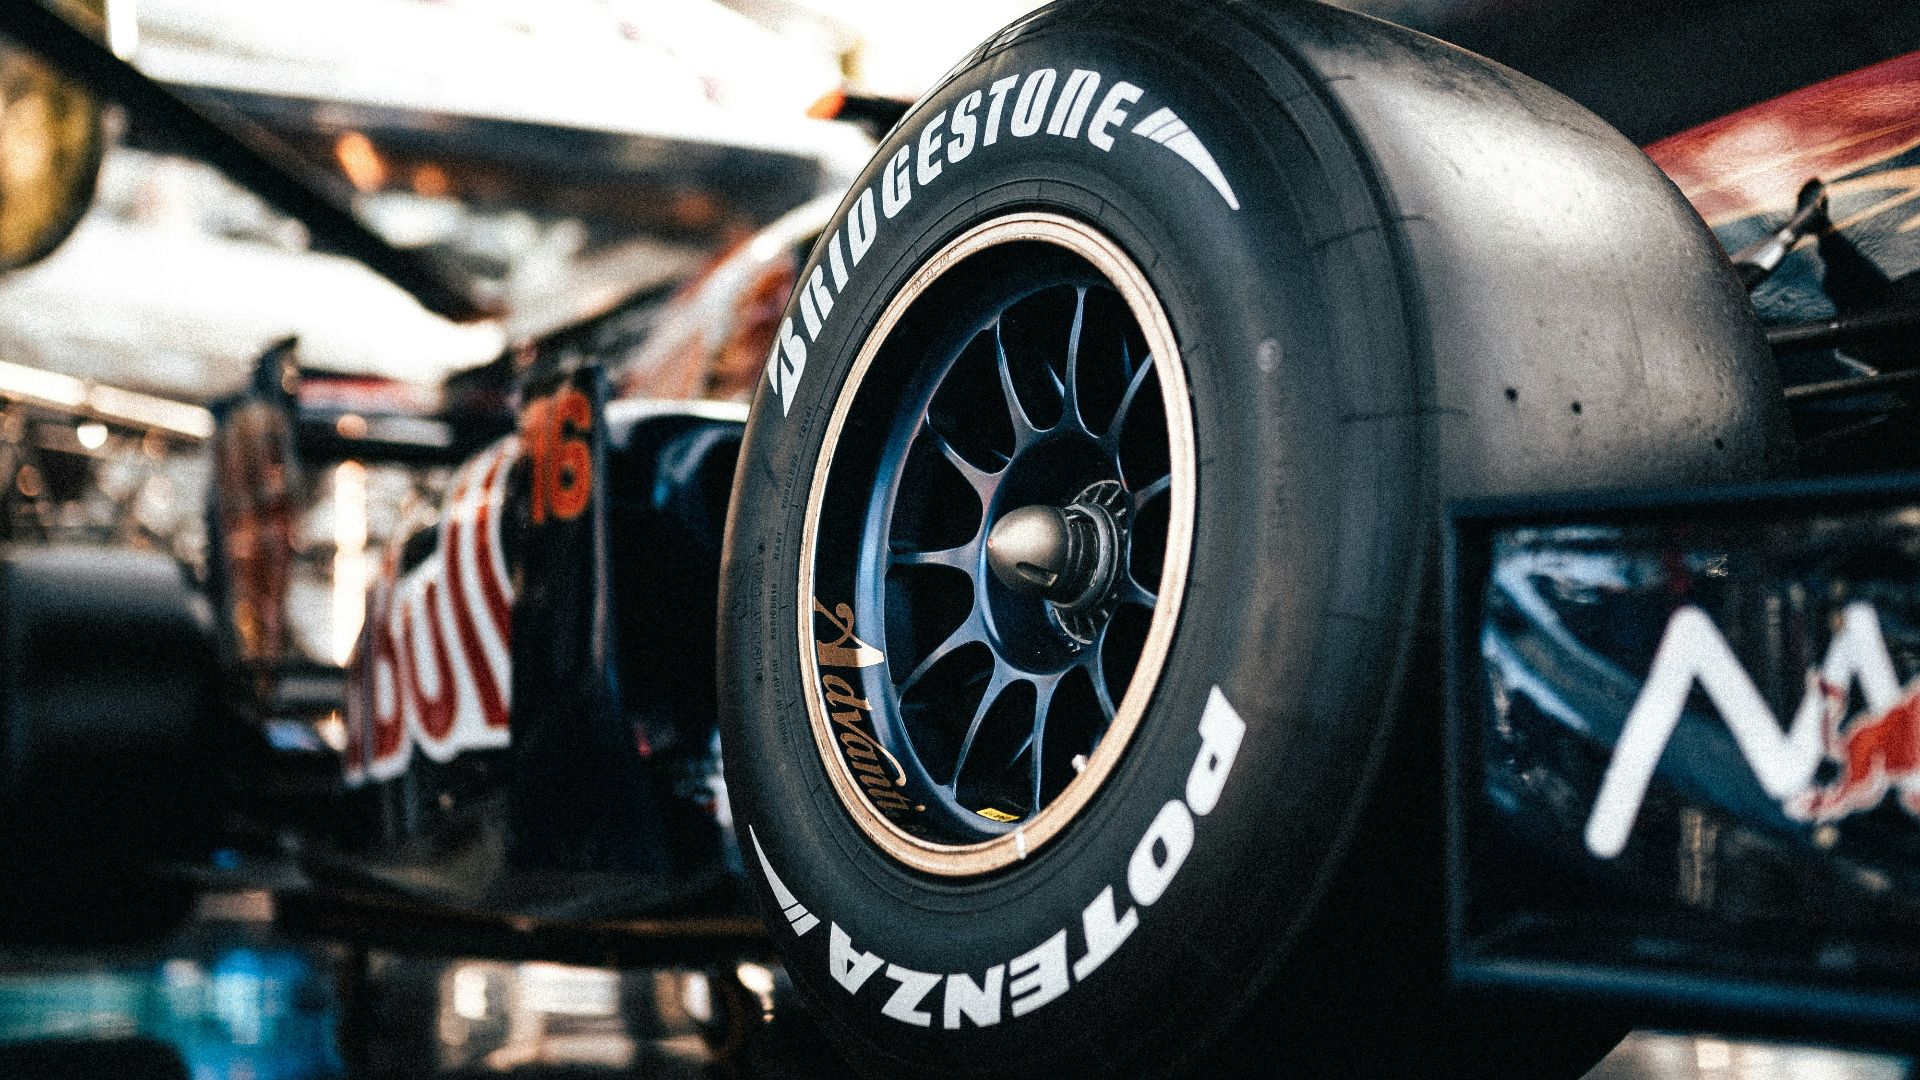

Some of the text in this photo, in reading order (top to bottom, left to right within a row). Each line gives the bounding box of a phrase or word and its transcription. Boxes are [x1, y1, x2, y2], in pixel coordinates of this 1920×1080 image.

[766, 68, 1145, 418] BRIDGESTONE
[522, 389, 593, 525] 16
[813, 596, 926, 812] Advanti
[830, 685, 1248, 1030] POTENZA
